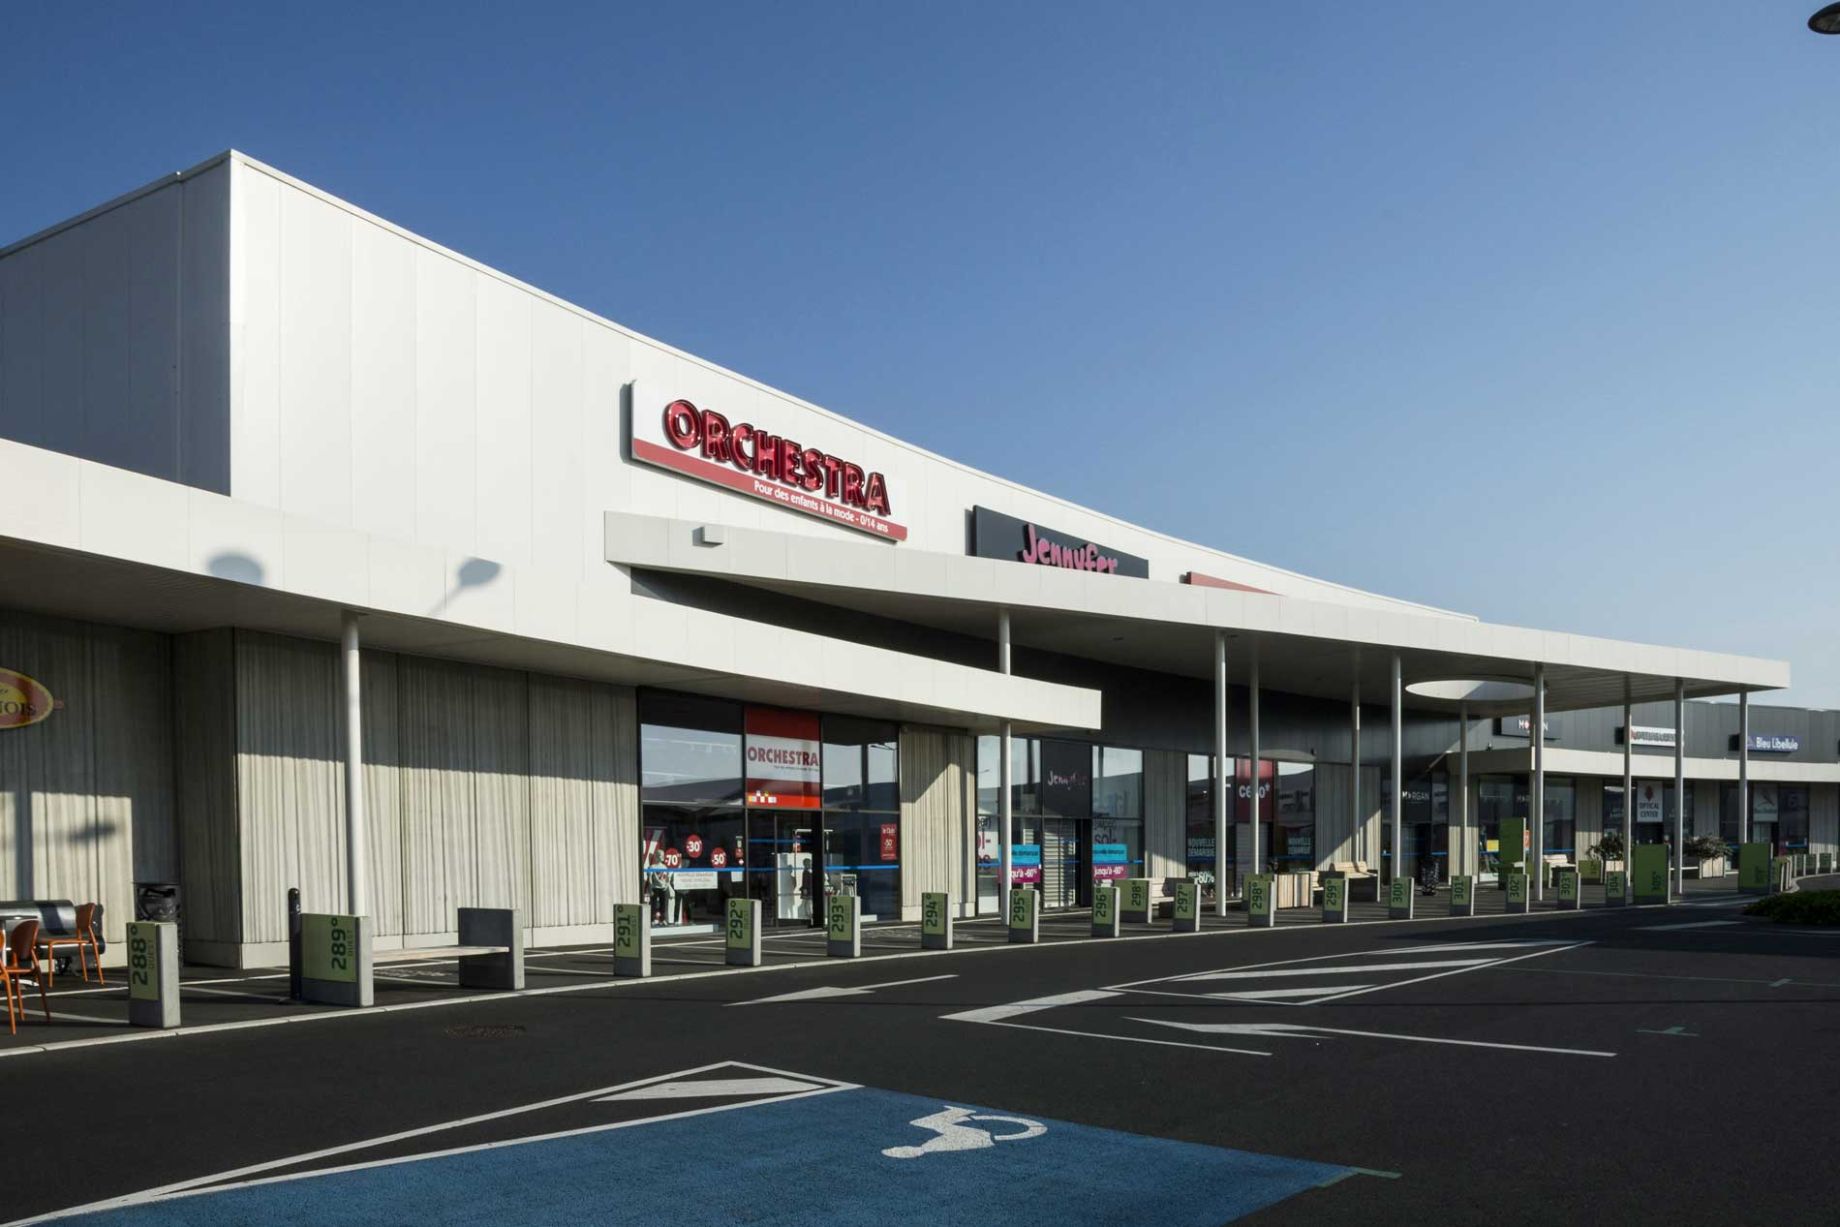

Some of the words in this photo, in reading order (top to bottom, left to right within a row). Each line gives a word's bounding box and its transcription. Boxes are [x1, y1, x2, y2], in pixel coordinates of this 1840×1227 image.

[662, 399, 892, 517] ORCHESTRA
[754, 480, 773, 496] Pour
[775, 487, 790, 502] des
[791, 494, 819, 510] enfants
[819, 502, 826, 513] à
[826, 504, 833, 515] la
[834, 509, 854, 522] mode
[876, 521, 889, 534] ans
[747, 746, 819, 766] ORCHESTRA
[1756, 736, 1771, 748] Bleu
[1639, 802, 1659, 810] OPTICAL
[831, 897, 844, 932] 293°
[925, 893, 938, 927] 294°
[1012, 890, 1025, 922] 295°
[1095, 887, 1106, 918] 296°
[1177, 884, 1188, 913] 297°
[617, 904, 631, 948] 291°
[730, 900, 743, 939] 292°
[131, 925, 148, 985] 288°
[331, 917, 347, 970] 289°
